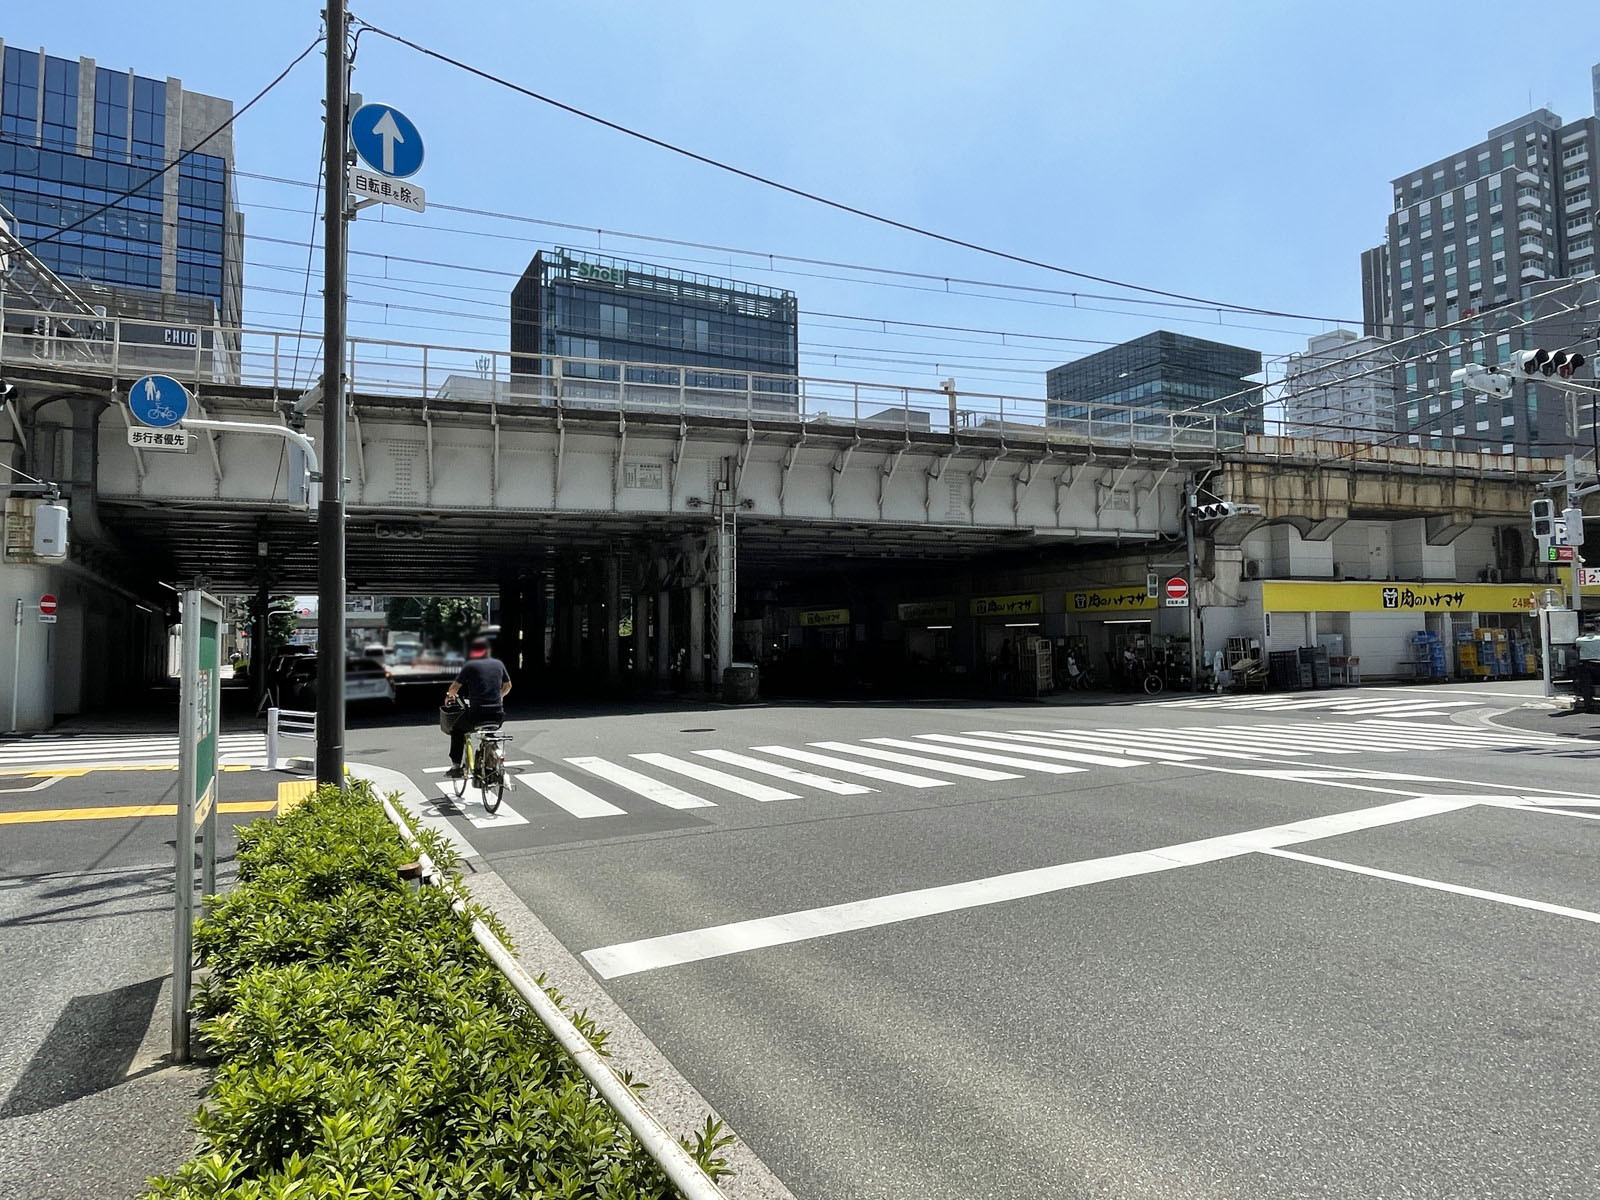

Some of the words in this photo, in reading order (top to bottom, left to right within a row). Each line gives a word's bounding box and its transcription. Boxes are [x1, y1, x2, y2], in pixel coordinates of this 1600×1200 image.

[356, 175, 419, 206] 自転車を除く
[164, 329, 197, 346] CHUO
[132, 431, 185, 446] 歩行者優先
[1088, 593, 1147, 608] 肉のハナマサ
[1400, 588, 1465, 608] 肉のハナマサ
